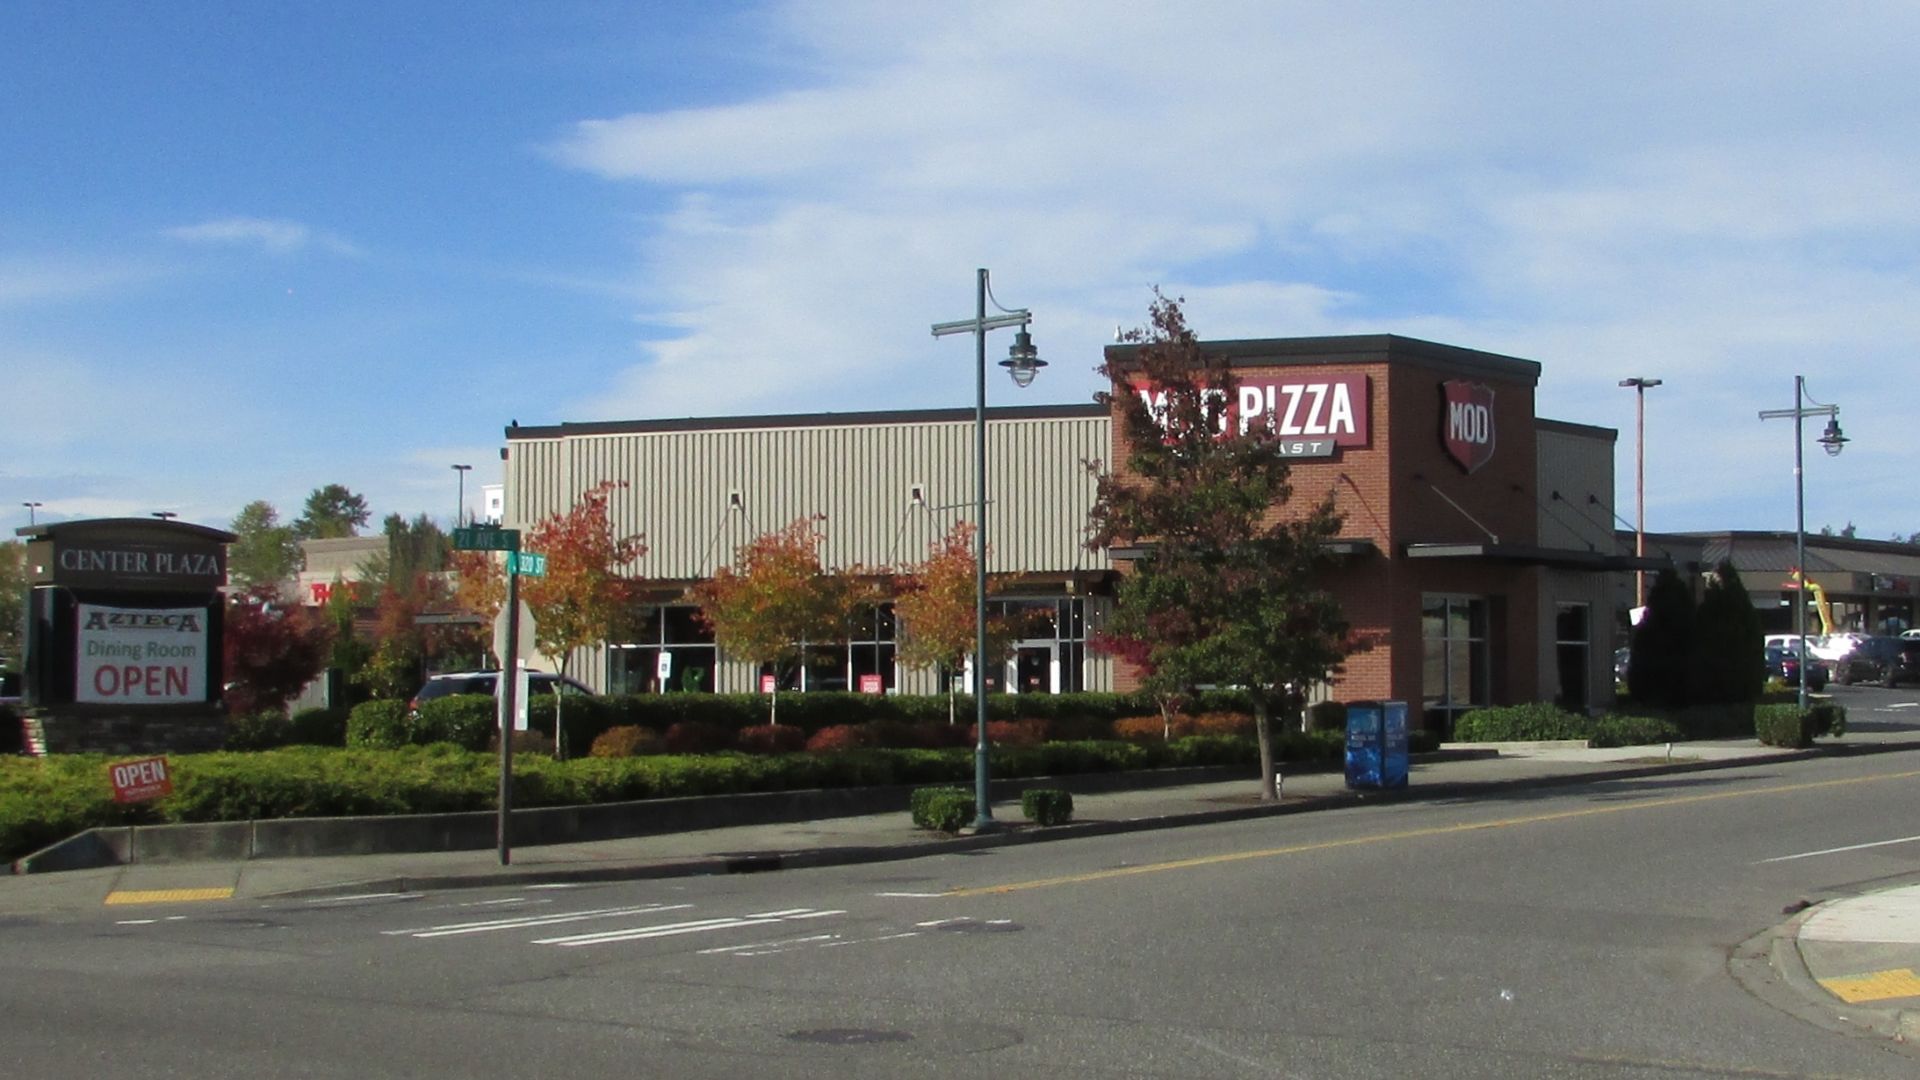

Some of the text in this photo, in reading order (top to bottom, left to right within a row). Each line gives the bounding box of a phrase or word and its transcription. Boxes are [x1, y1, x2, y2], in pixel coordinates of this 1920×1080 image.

[1239, 383, 1355, 437] PIZZA
[1449, 401, 1488, 444] MOD
[60, 550, 219, 576] CENTER PLAZA
[535, 557, 545, 574] ST
[84, 611, 201, 632] AZTECA
[87, 640, 197, 660] Dining Room
[93, 664, 188, 696] OPEN
[114, 759, 166, 788] OPEN
